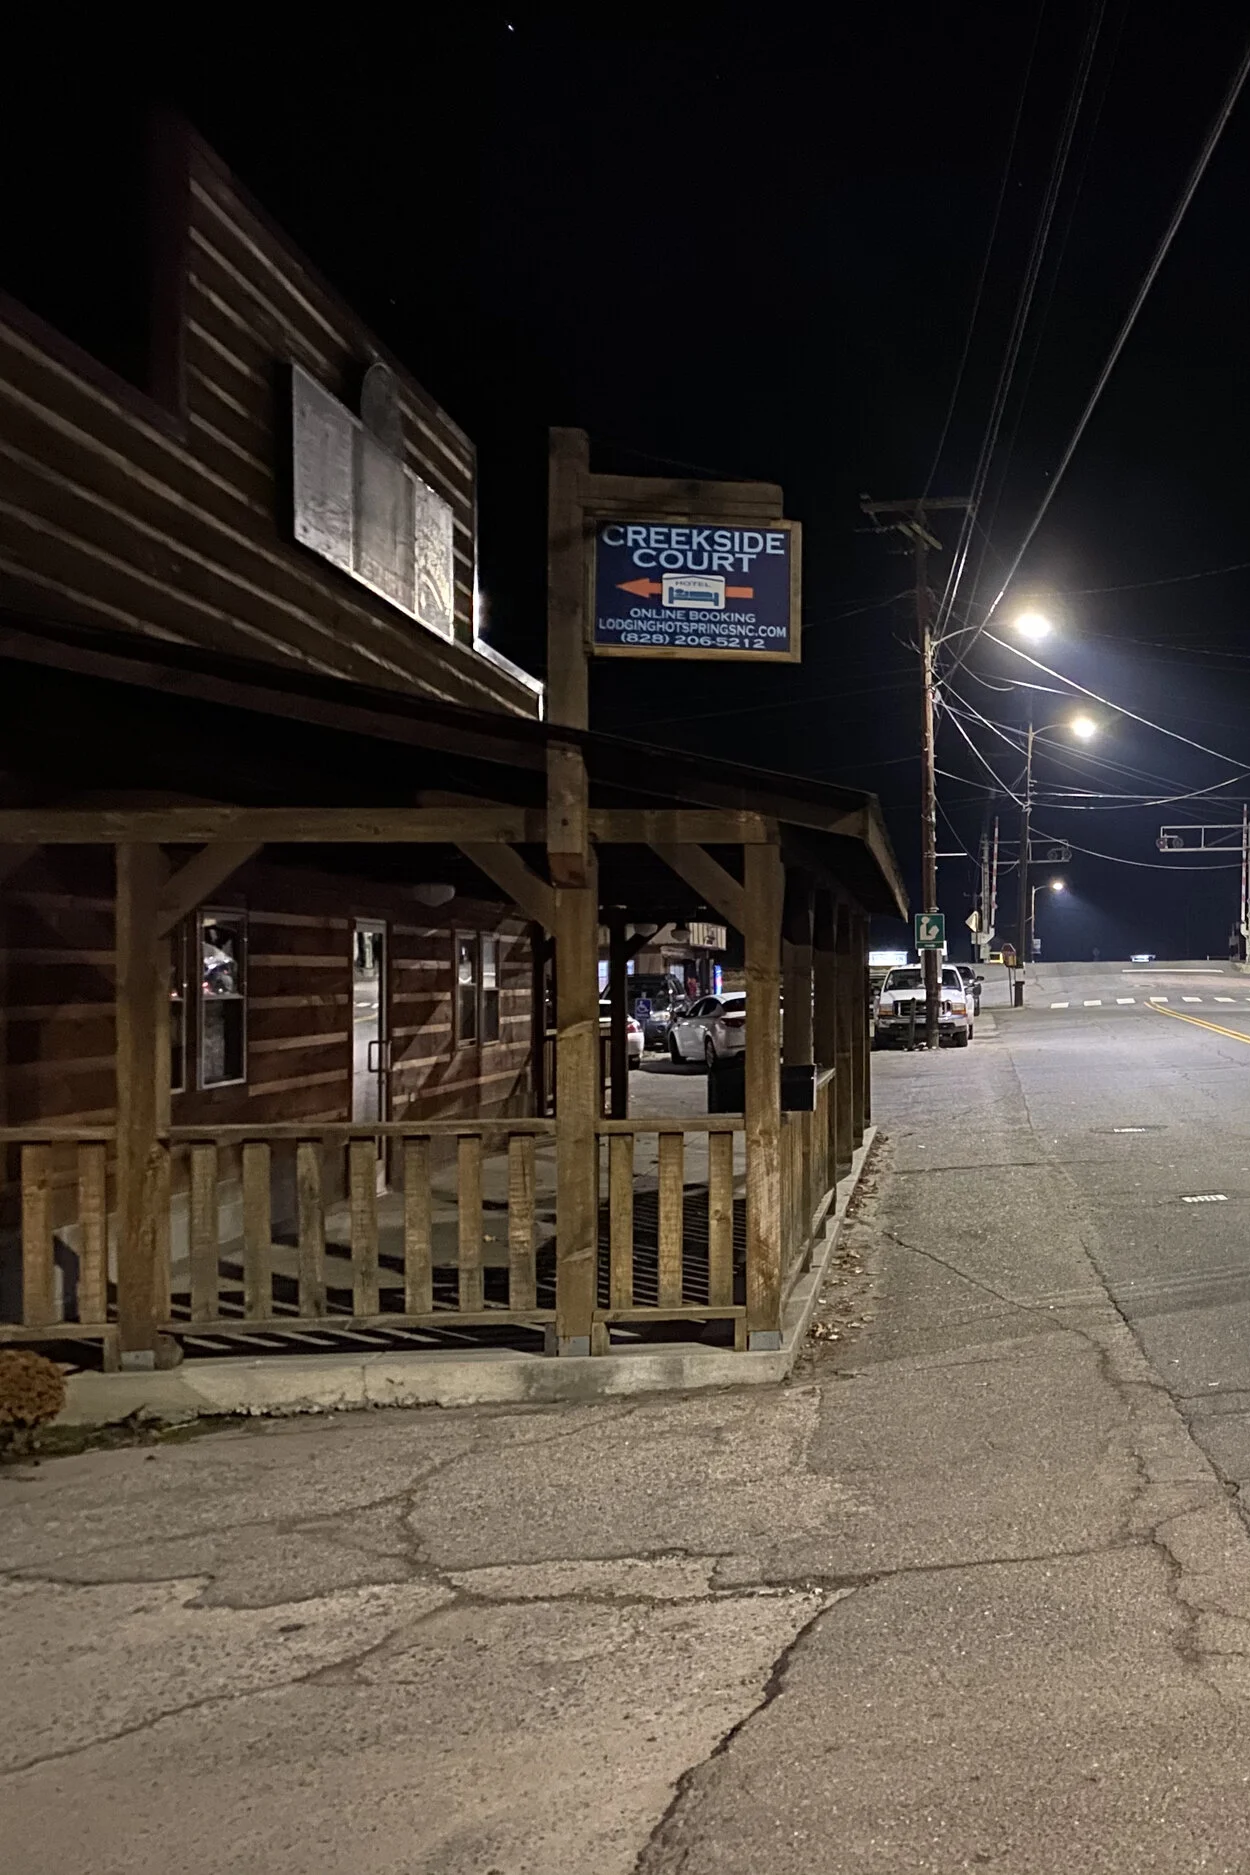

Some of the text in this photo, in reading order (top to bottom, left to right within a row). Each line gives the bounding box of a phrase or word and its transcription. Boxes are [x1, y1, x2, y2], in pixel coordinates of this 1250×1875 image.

[602, 525, 785, 555] CREEKSIDE
[632, 549, 757, 573] COURT
[675, 580, 712, 588] HOTEL
[630, 608, 756, 623] ONLINE BOOKING
[599, 618, 787, 638] LODGINGHOTSPRINGSNC.COM
[620, 632, 766, 649] (828) 206-5212
